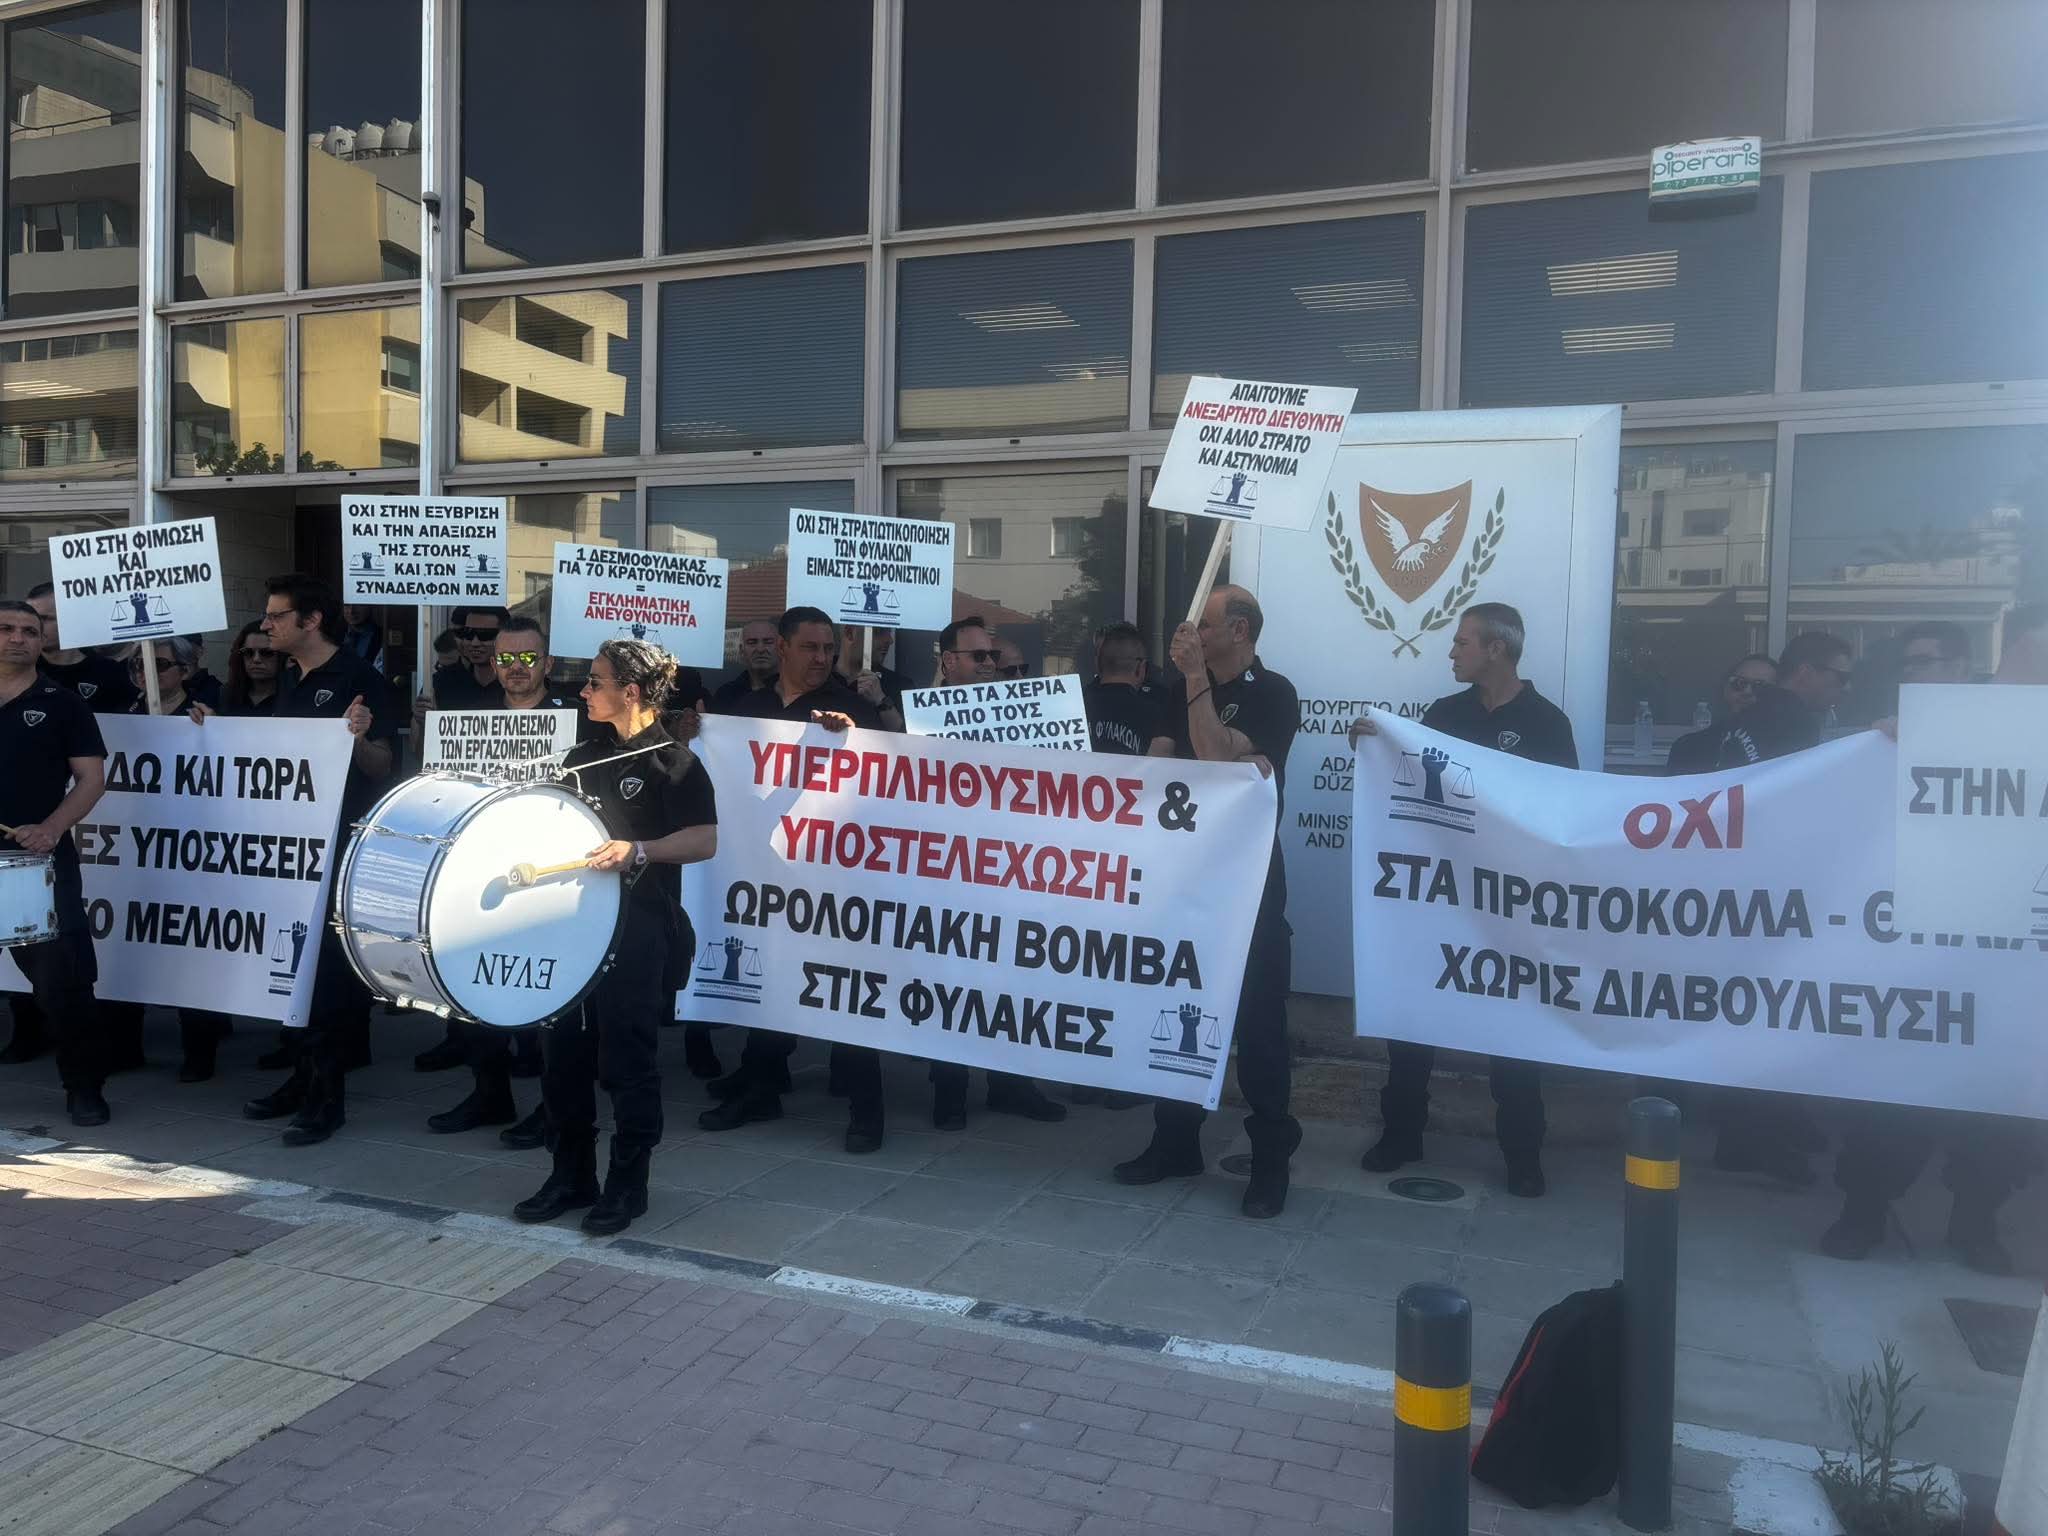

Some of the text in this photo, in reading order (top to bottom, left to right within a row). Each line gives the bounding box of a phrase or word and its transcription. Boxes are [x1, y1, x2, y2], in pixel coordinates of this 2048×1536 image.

[1653, 143, 1760, 181] piperaris
[1230, 384, 1309, 406] ΑΠΑΙΤΟΥΜΕ
[1183, 402, 1344, 433] ΑΝΕΞΑΡΤΗΤΟ ΔΙΕΥΘΥΝΤΗ
[1199, 425, 1311, 454] ΟΧΙ ΑΛΛΟ ΣΤΡΑΤΟ
[1198, 448, 1299, 476] ΚΑΙ ΑΣΤΥΝΟΜΙΑ
[349, 504, 499, 519] ΟΧΙ ΣΤΗΝ ΕΞΥΒΡΙΣΗ
[62, 524, 204, 559] ΟΧΙ ΣΤΗ ΦΙΜΩΣΗ
[352, 524, 496, 538] ΚΑΙ ΤΗΝ ΑΠΑΞΙΩΣΗ
[797, 514, 950, 545] ΟΧΙ ΣΤΗ ΣΤΡΑΤΙΩΤΙΚΟΠΟΙΗΣΗ
[118, 551, 147, 572] ΚΑΙ
[379, 543, 471, 557] ΤΗΣ ΣΤΟΛΗΣ
[576, 548, 707, 573] 1 ΔΕΣΜΟΦΥΛΑΚΑΣ
[834, 538, 912, 563] ΤΩΝ ΦΥΛΑΚΩΝ
[62, 563, 212, 599] ΤΟΝ ΑΥΤΑΡΧΙΣΜΟ
[395, 563, 456, 576] ΚΑΙ ΤΩΝ
[559, 560, 722, 588] ΓΙΑ 70 ΚΡΑΤΟΥΜΕΝΟΥΣ
[807, 557, 940, 586] ΕΙΜΑΣΤΕ ΣΩΦΡΟΝΙΣΤΙΚΟΙ
[356, 581, 499, 596] ΣΥΝΑΔΕΛΦΩΝ ΜΑΣ
[589, 591, 690, 613] ΕΓΚΛΗΜΑΤΙΚΗ
[584, 606, 697, 628] ΑΝΕΥΘΥΝΟΤΗΤΑ
[912, 679, 1066, 708] ΚΑΤΩ ΤΑ ΧΕΡΙΑ
[944, 702, 1042, 727] ΑΠΟ ΤΟΥΣ
[1398, 702, 1431, 718] ΔΙΚ
[439, 715, 556, 736] ΟΧΙ ΣΤΟΝ ΕΓΚΛΕΙΣΜΟ
[926, 718, 1085, 743] ΜΑΤΟΥΧΟΥΣ
[1298, 718, 1326, 734] ΚΑΙ
[440, 739, 552, 760] ΤΩΝ ΕΡΓΑΖΟΜΕΝΩΝ
[105, 752, 316, 802] ΔΩ ΚΑΙ ΤΩΡΑ
[1320, 757, 1355, 771] ADA
[748, 740, 1198, 832] ΥΠΕΡΠΛΗΘΥΣΜΟΣ &
[1314, 773, 1354, 791] DÜZ
[1909, 766, 2026, 817] ΣΤΗΝ
[1298, 812, 1353, 830] MINIS
[1623, 784, 1744, 849] ΟΧΙ
[75, 824, 326, 882] ΕΣ ΥΠΟΣΧΕΣΕΙΣ
[1305, 832, 1345, 849] AND
[780, 815, 1142, 905] ΥΠΟΣΤΕΛΕΧΩΣΗ:
[1373, 851, 1459, 906] ΣΤΑ
[1473, 866, 1813, 938] ΠΡΩΤΟΚΟΛΛΑ
[1828, 914, 1847, 926] -
[82, 898, 266, 955] Ο ΜΕΛΛΟΝ
[723, 880, 1203, 990] ΩΡΟΛΟΓΙΑΚΗ ΒΟΜΒΑ
[472, 951, 558, 991] EVAN
[1434, 943, 1976, 1046] ΧΩΡΙΣ ΔΙΑΒΟΥΛΕΥΣΗ
[798, 961, 1115, 1058] ΣΤΙΣ ΦΥΛΑΚΕΣ
